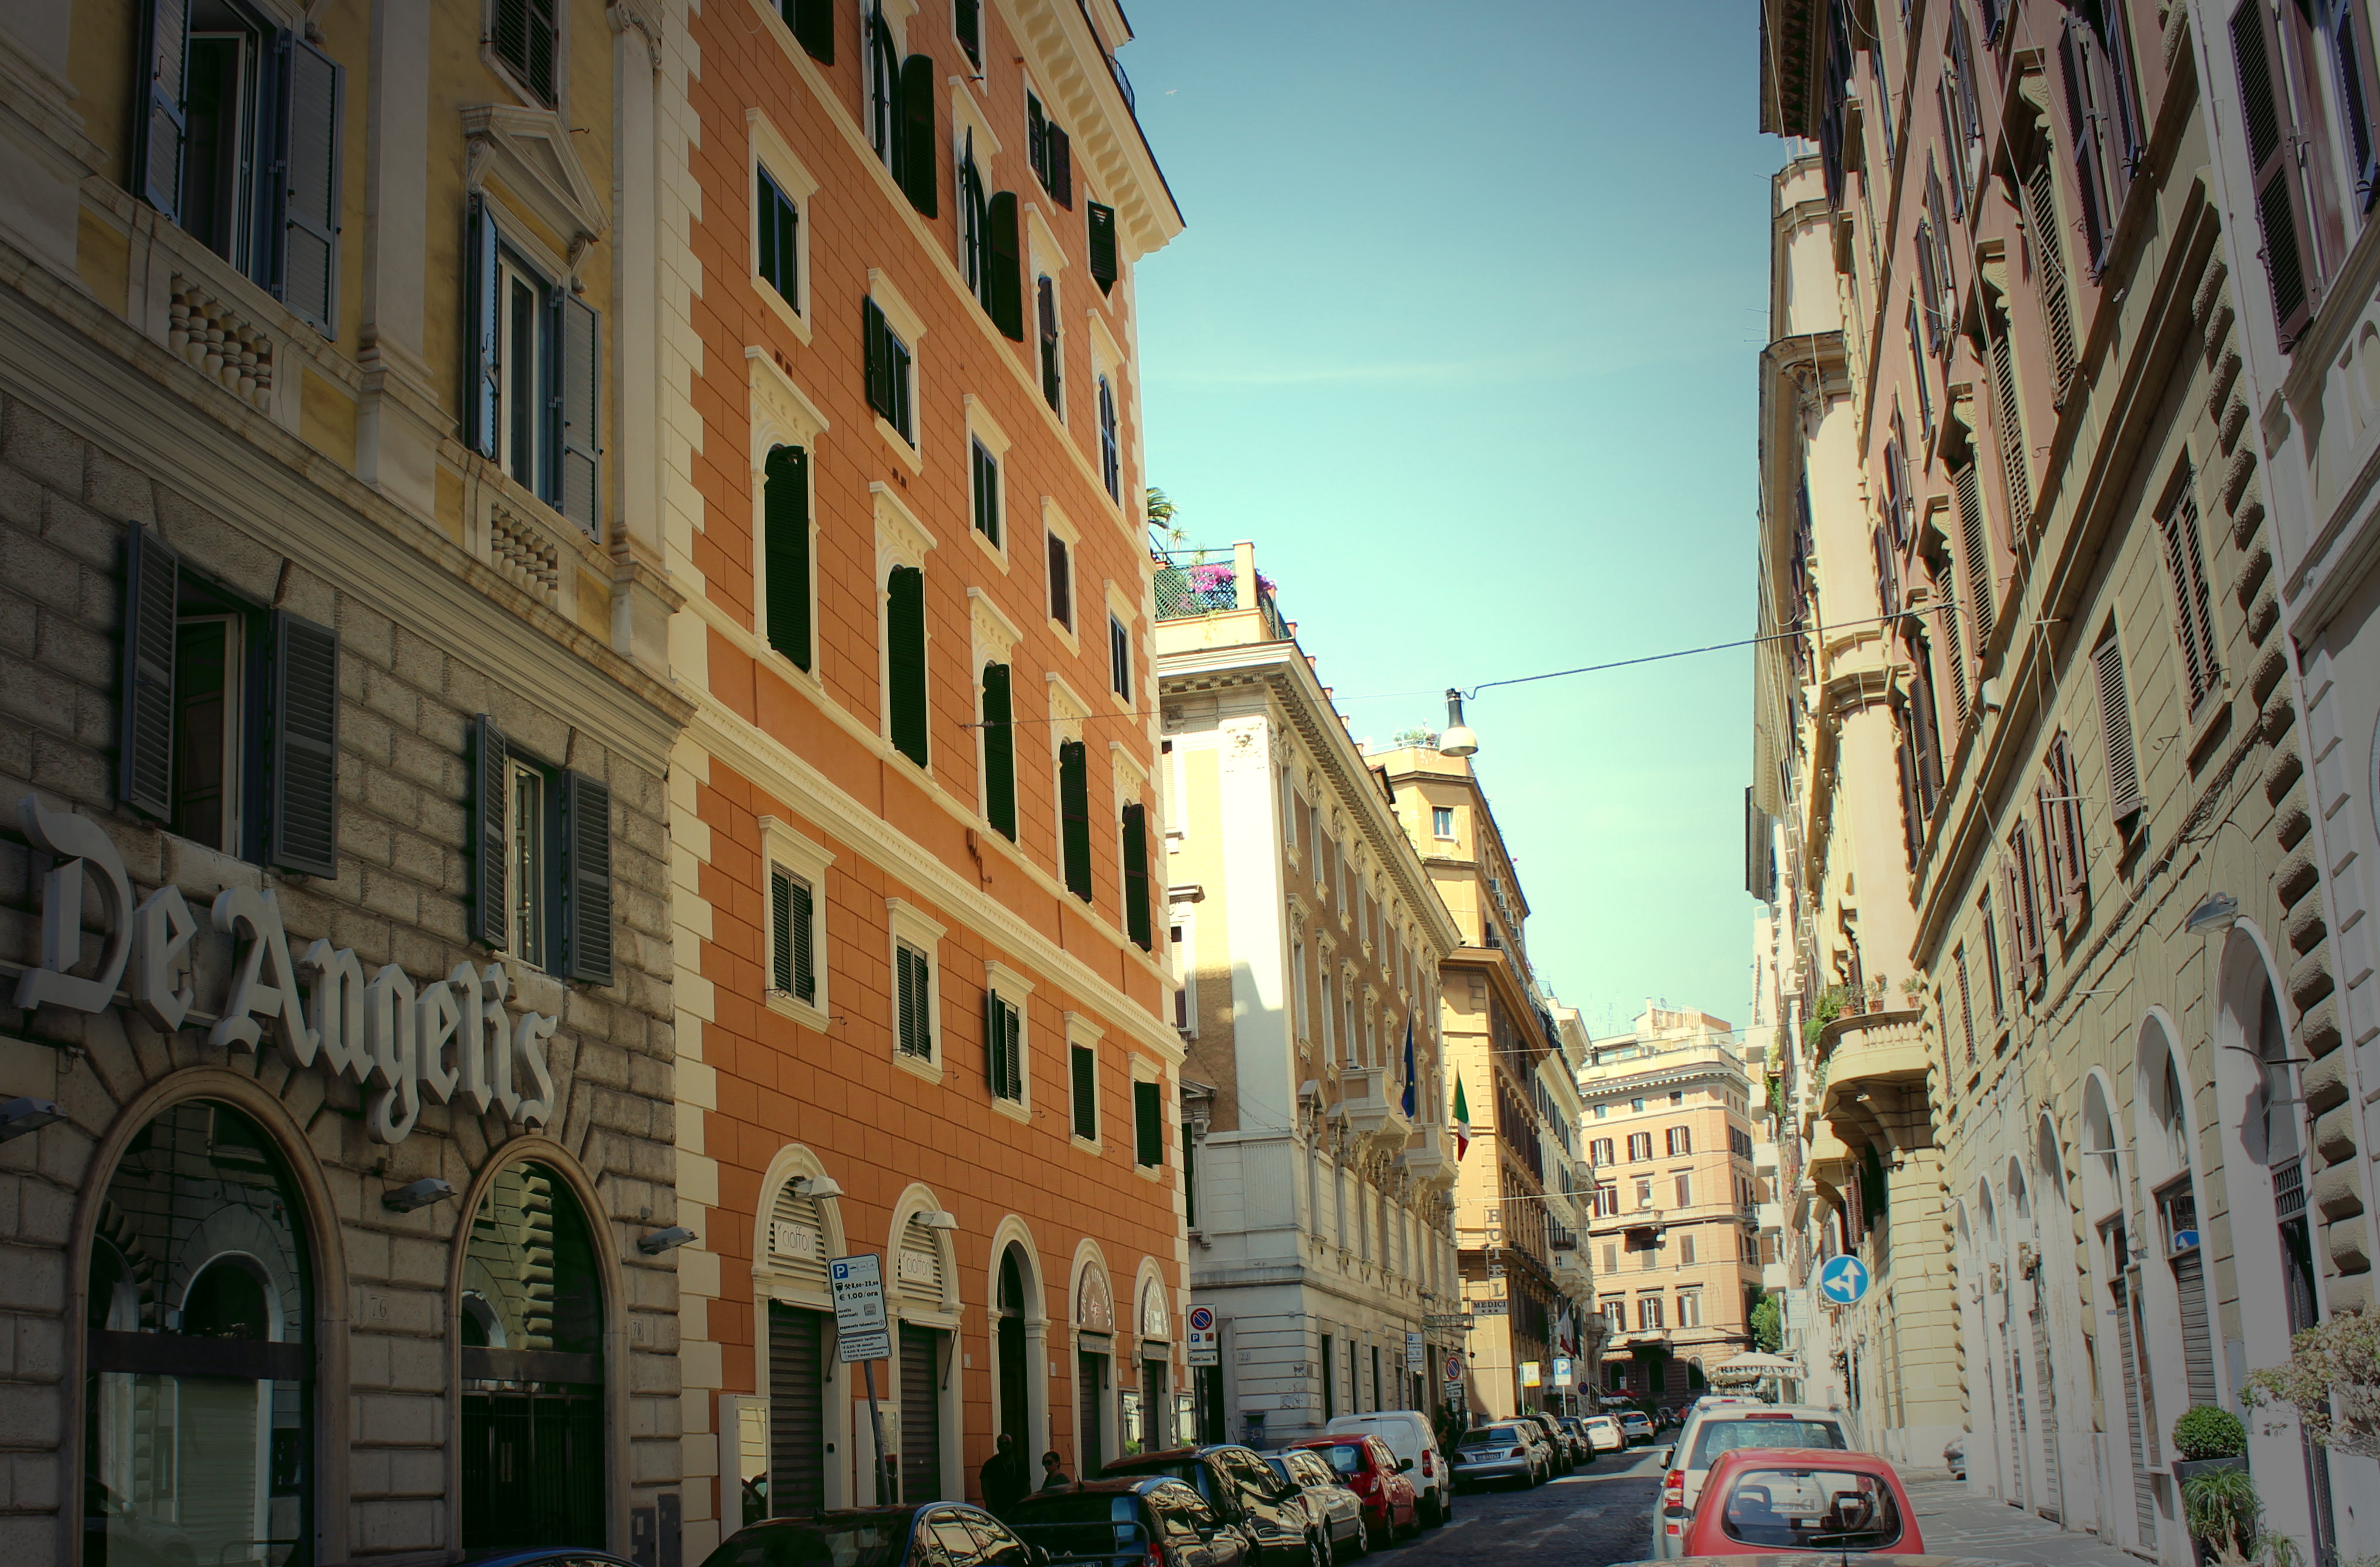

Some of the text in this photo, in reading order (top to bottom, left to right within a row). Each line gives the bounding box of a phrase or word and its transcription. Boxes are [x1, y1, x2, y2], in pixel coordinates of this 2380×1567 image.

[12, 793, 558, 1145] De Angelis
[1487, 1209, 1505, 1297] HOTEL
[836, 1265, 845, 1278] P
[848, 1291, 878, 1300] 1,00/ora
[371, 1297, 387, 1317] 76
[1557, 1361, 1568, 1374] P
[1721, 1366, 1801, 1375] RISTORANTE
